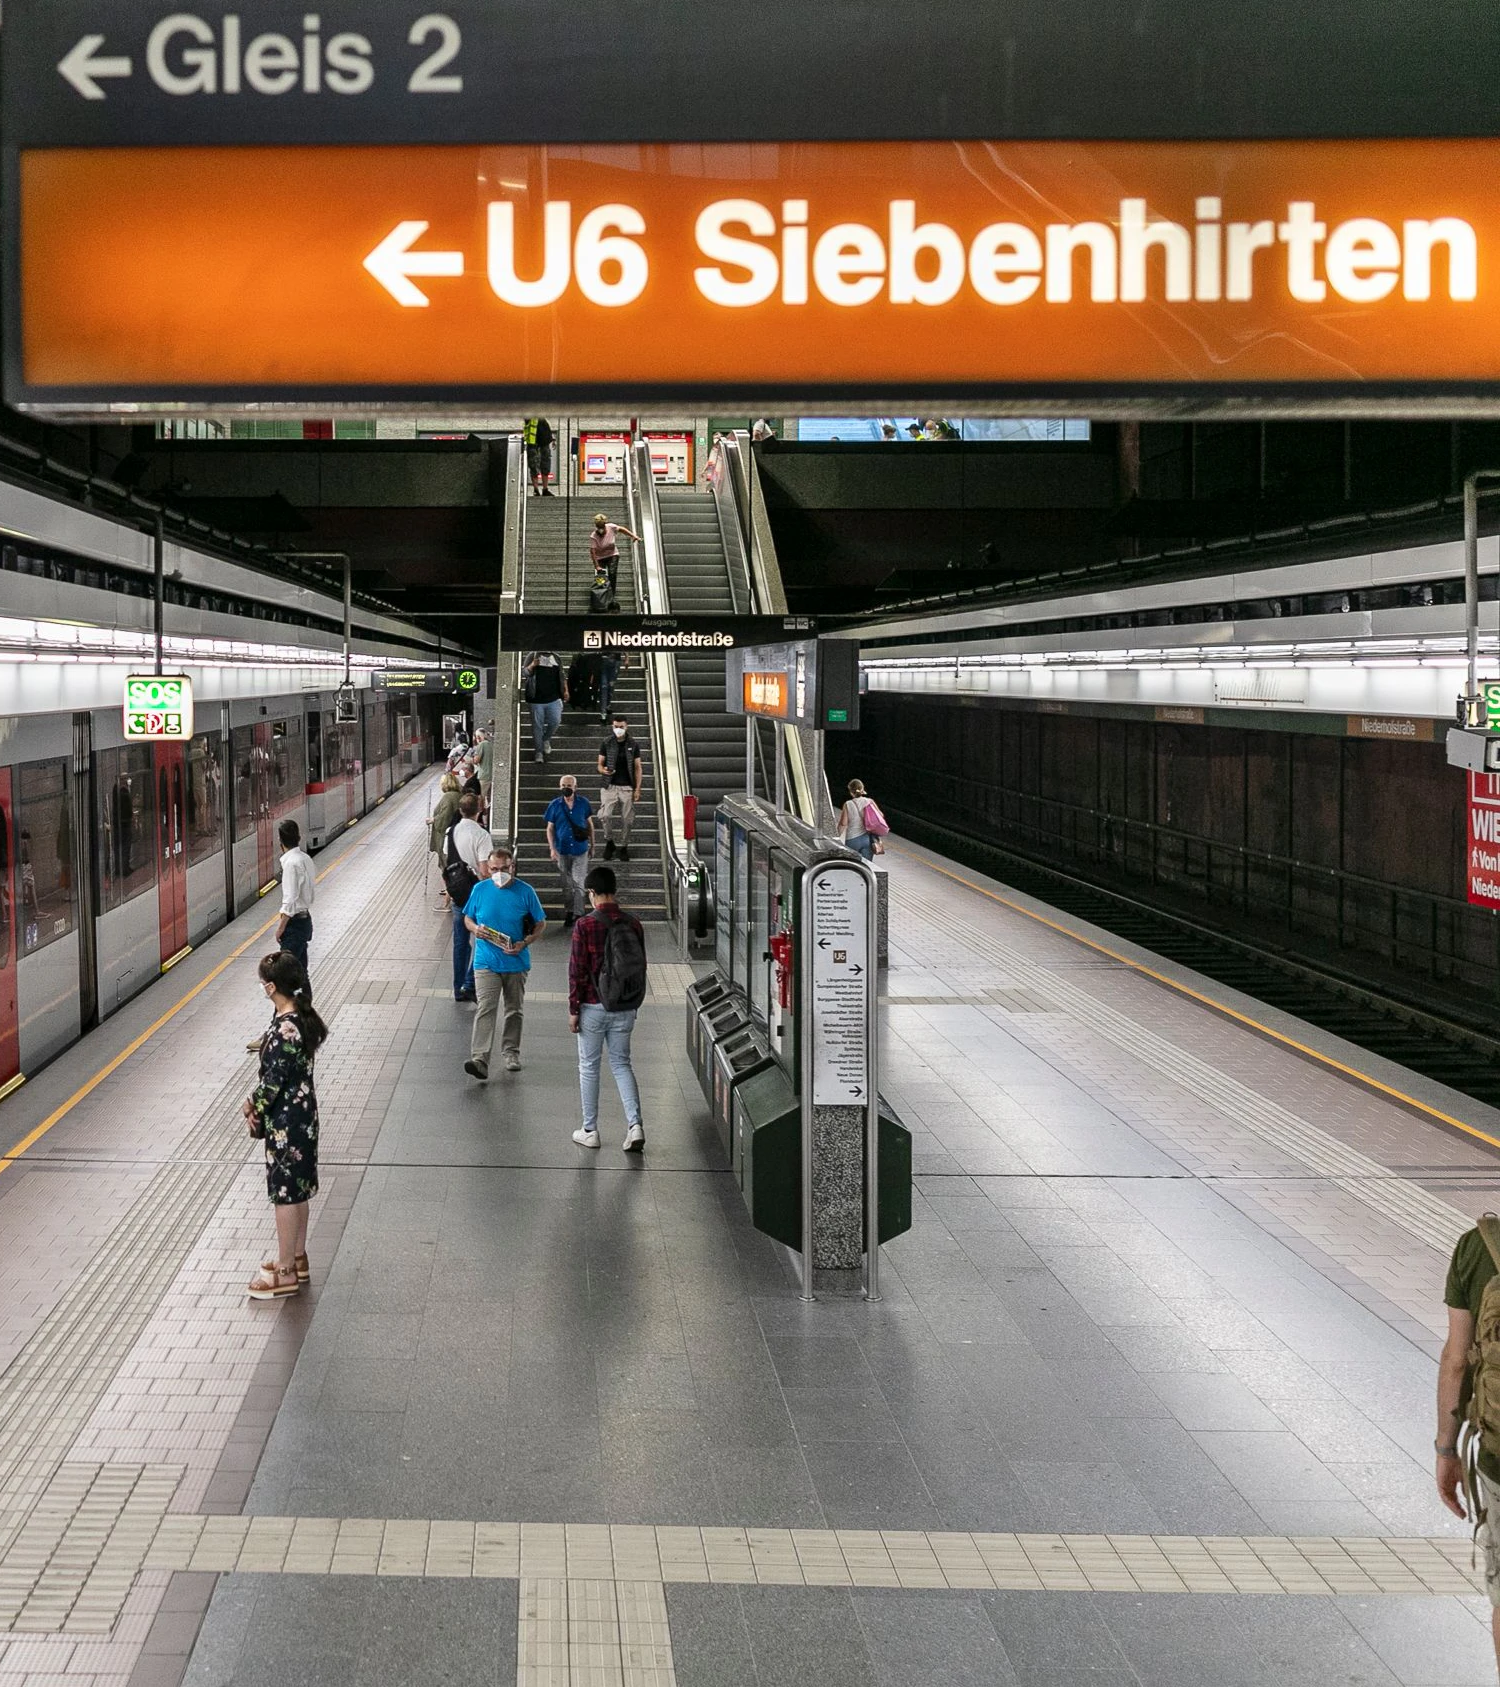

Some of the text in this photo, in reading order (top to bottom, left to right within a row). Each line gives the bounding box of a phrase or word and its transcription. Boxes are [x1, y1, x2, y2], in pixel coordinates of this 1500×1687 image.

[147, 15, 462, 94] Gleis 2
[486, 197, 1477, 307] U6 Siebenhirten
[641, 617, 678, 628] Ausgang
[604, 630, 734, 647] Niederhofstraße
[129, 682, 181, 706] SOS
[1478, 849, 1497, 871] Von
[834, 951, 846, 961] U6
